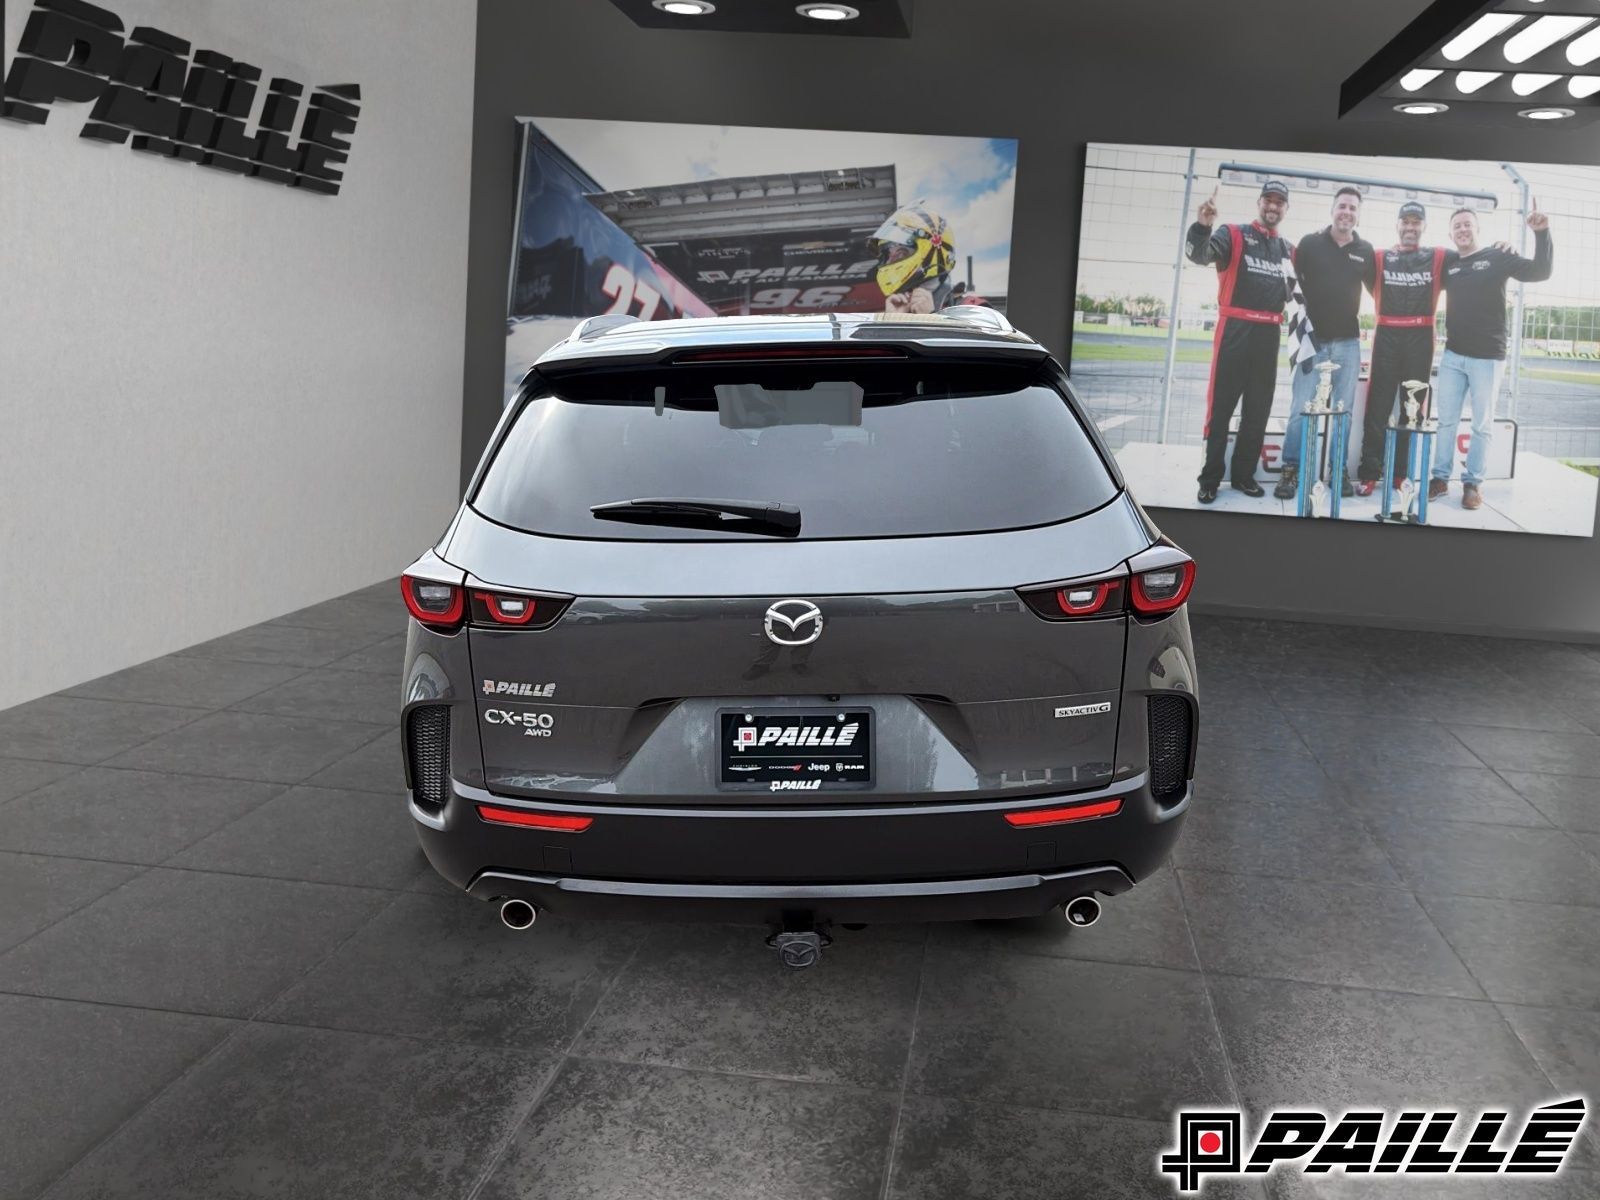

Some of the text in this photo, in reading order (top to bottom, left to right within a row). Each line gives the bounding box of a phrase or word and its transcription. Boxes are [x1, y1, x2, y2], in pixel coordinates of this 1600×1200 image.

[0, 0, 361, 196] PAILLÉ
[751, 286, 852, 309] 96
[484, 708, 554, 728] CX-50
[524, 728, 552, 737] AWD
[758, 722, 859, 747] PAILLÉ
[808, 763, 830, 772] Jeep
